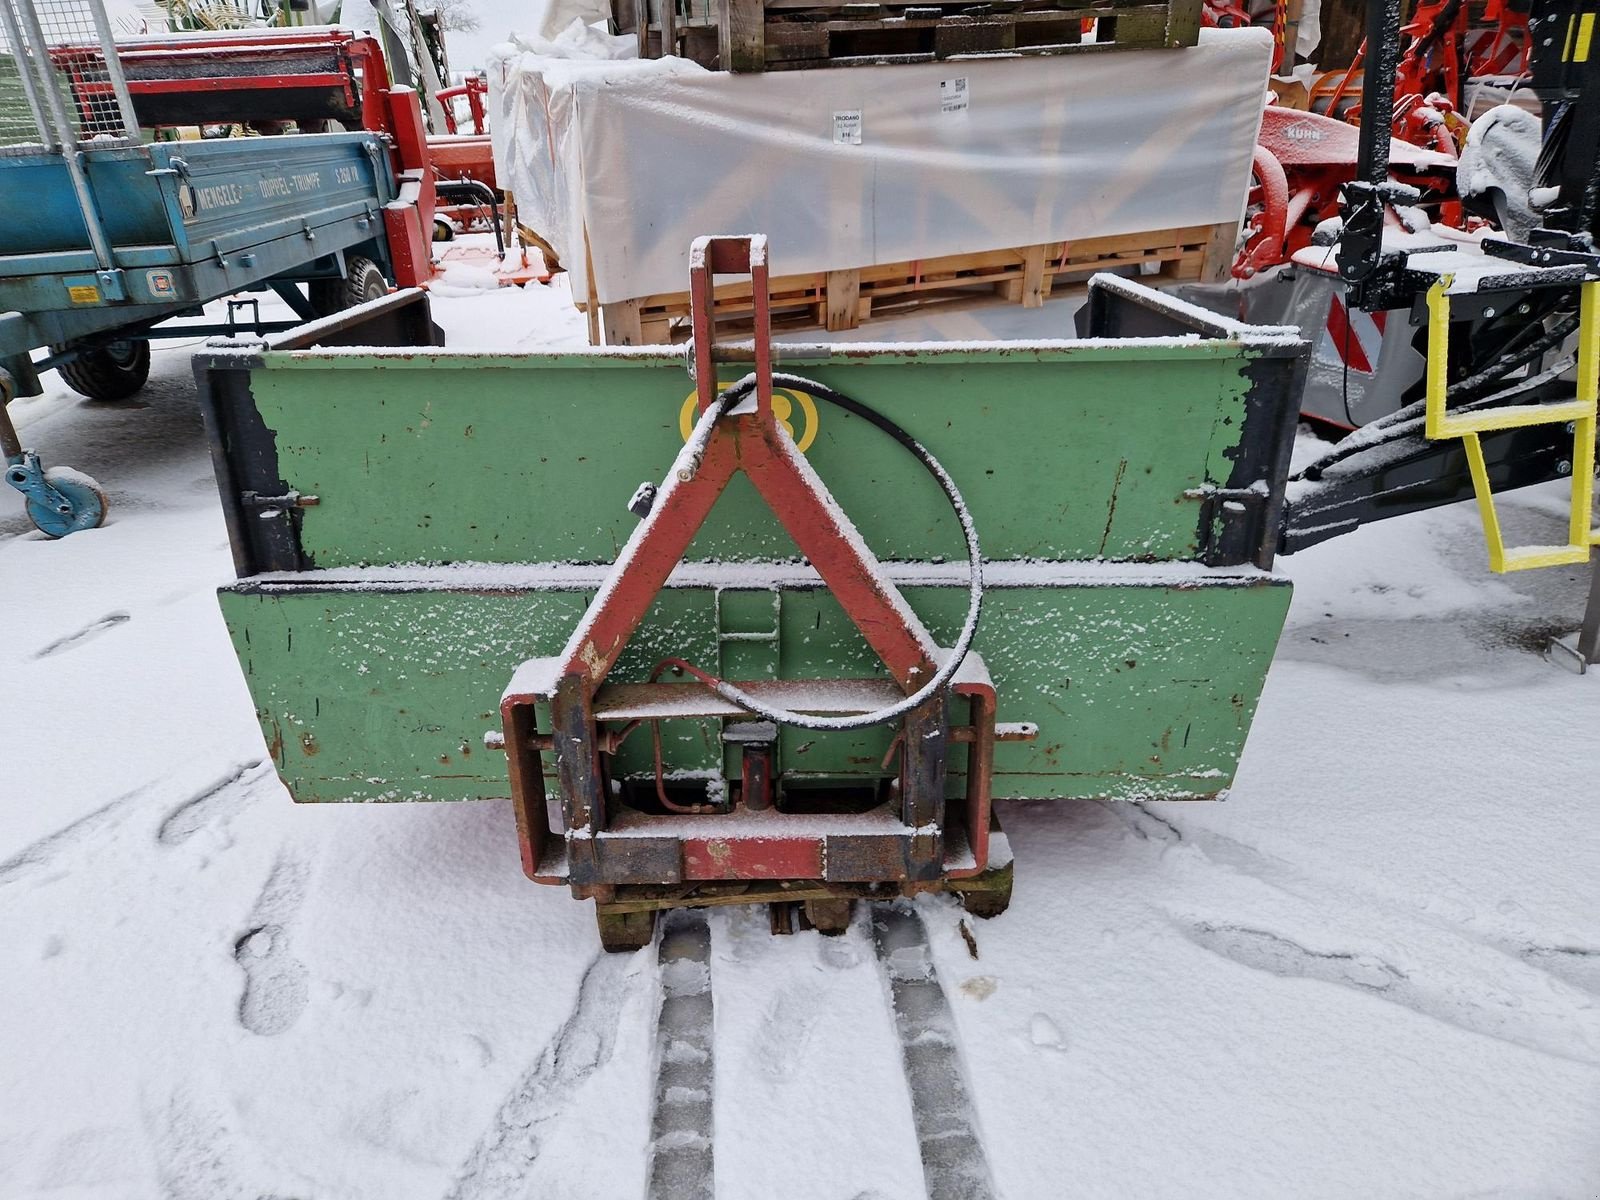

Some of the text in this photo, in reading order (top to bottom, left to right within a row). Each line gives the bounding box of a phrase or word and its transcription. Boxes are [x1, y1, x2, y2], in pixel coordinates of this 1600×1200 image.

[1287, 127, 1321, 140] KUHN
[196, 183, 242, 210] MENGELE
[258, 172, 321, 199] DOPPEL-TRUMPF
